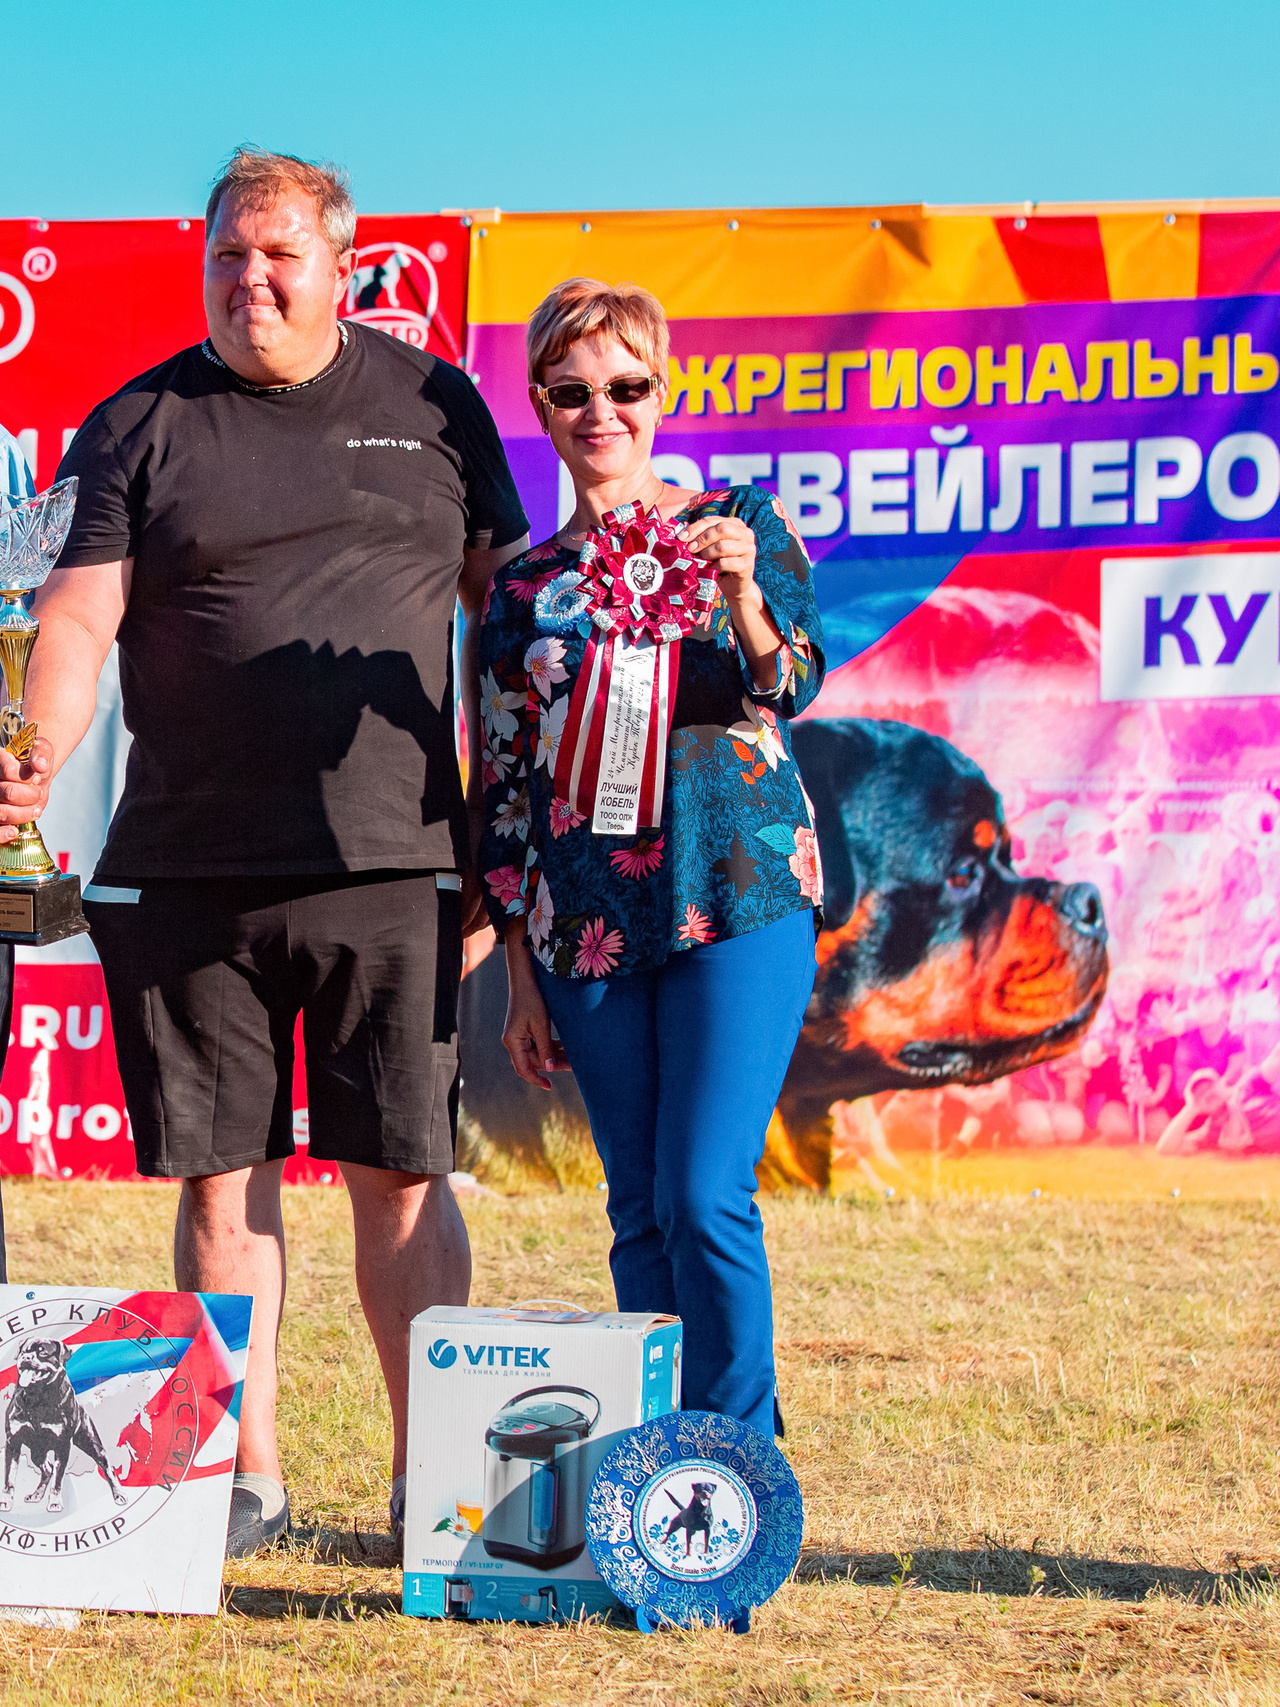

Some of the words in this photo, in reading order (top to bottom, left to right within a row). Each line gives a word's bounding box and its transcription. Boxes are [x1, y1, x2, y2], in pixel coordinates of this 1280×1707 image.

[662, 332, 1280, 416] ЖРЕГИОНАЛЬН
[347, 438, 361, 448] do
[363, 437, 397, 447] what's
[399, 438, 422, 451] right
[1144, 591, 1280, 668] КУ
[600, 781, 638, 795] ЛУЧШИЙ
[600, 796, 634, 809] КОБЕЛЬ
[607, 822, 625, 831] Тверь
[463, 1344, 551, 1369] VITEK
[463, 1368, 500, 1377] ТЕХНИКА
[503, 1370, 519, 1378] ДЛЯ
[68, 1303, 154, 1347] КЛУБ
[157, 1353, 194, 1493] РОССИИ
[422, 1558, 463, 1568] ТЕРМОПОТ
[411, 1578, 422, 1596] 1
[486, 1581, 498, 1599] 2
[566, 1585, 578, 1603] 3
